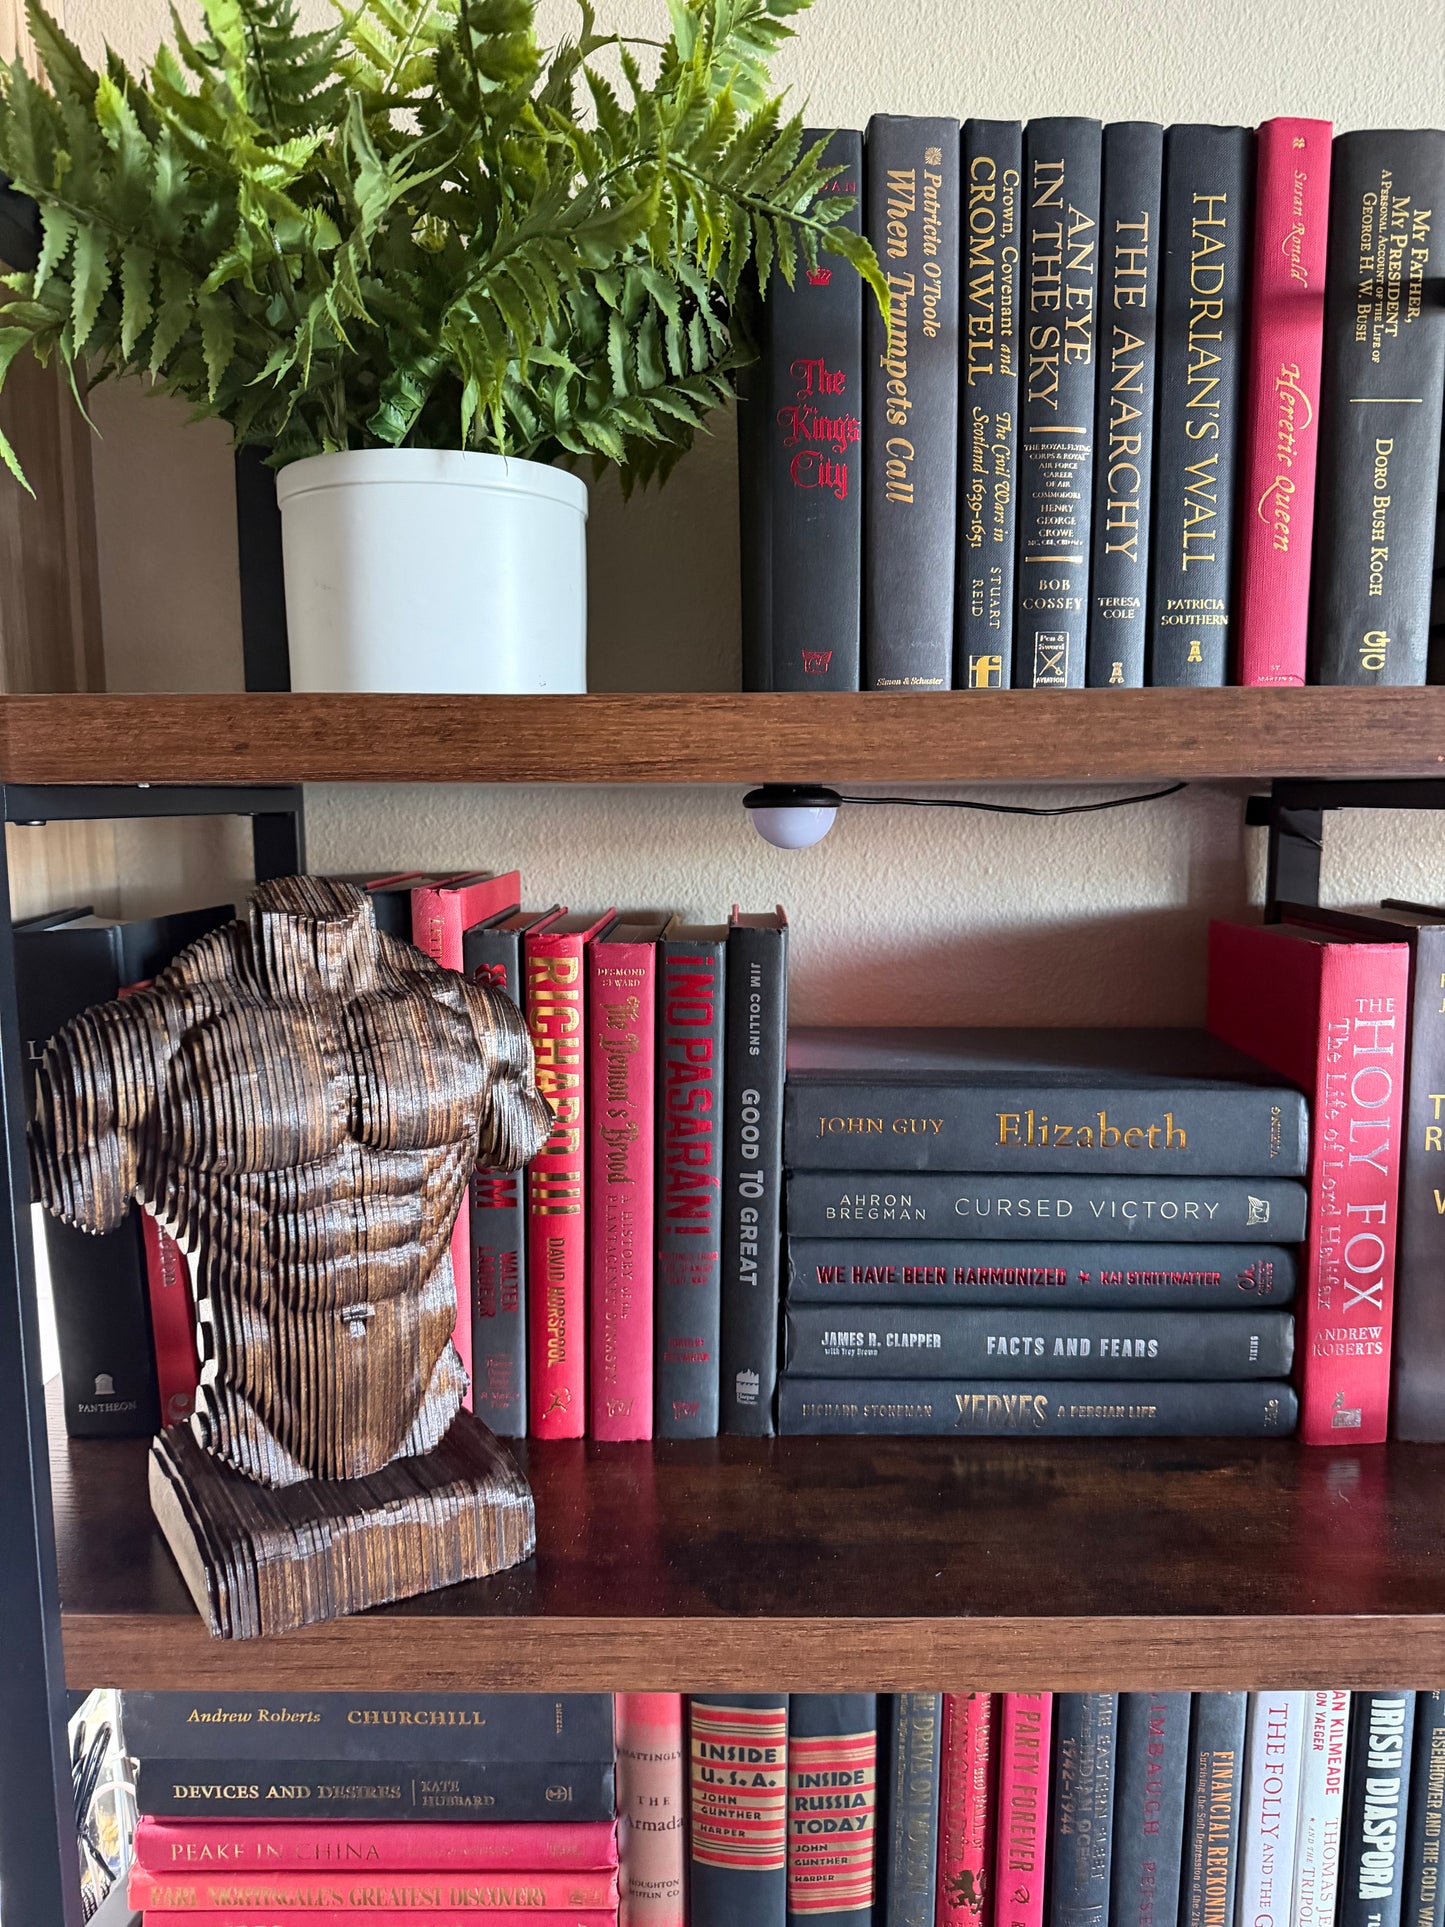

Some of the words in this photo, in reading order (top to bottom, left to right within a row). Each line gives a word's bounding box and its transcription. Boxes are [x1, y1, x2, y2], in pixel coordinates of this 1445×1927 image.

[1032, 158, 1065, 209] IN
[1291, 169, 1307, 216] Susan
[886, 167, 916, 259] When
[922, 169, 942, 257] Patricia
[1066, 203, 1096, 275] AN
[1030, 220, 1063, 313] THE
[1113, 210, 1150, 310] THE
[1281, 222, 1308, 288] Ronald
[967, 156, 997, 387] CROMWELL
[922, 264, 942, 338] O'Toole
[1000, 246, 1019, 337] Covenant
[1063, 284, 1093, 365] EYE
[1185, 192, 1227, 440] HADRIAN'S
[880, 271, 916, 426] Trumpets
[999, 343, 1017, 378] and
[790, 357, 847, 402] The
[1028, 325, 1061, 411] SKY
[776, 404, 860, 453] King's
[995, 411, 1012, 441] The
[1275, 363, 1313, 468] Heretic
[972, 406, 990, 475] Scotland
[1041, 443, 1067, 451] ROYAL
[1105, 324, 1146, 563] ANARCHY
[991, 444, 1011, 479] Civil
[1029, 452, 1055, 460] CORPS
[1055, 452, 1062, 460] &
[1063, 452, 1087, 461] ROYAL
[1054, 462, 1078, 470] FORCE
[790, 449, 849, 500] City
[885, 437, 916, 504] Call
[1043, 471, 1073, 479] CAREER
[993, 480, 1010, 524] Wars
[1032, 491, 1082, 500] COMMODORE
[1040, 504, 1074, 513] HENRY
[1036, 516, 1077, 526] GEORGE
[1181, 453, 1219, 572] WALL
[1257, 474, 1296, 552] Queen
[993, 527, 1009, 543] in
[1038, 528, 1074, 538] CROWE
[988, 566, 1002, 629] STUART
[1039, 579, 1071, 591] BOB
[971, 579, 984, 618] REID
[1023, 597, 1082, 611] COSSEY
[1098, 597, 1141, 608] TERESA
[1166, 599, 1225, 611] PATRICIA
[1102, 608, 1136, 619] COLE
[1161, 614, 1229, 626] SOUTHERN
[1038, 643, 1065, 651] Sword
[1039, 634, 1056, 642] Pen
[1056, 634, 1065, 642] &
[876, 677, 901, 686] Simon
[902, 677, 910, 686] &
[910, 676, 944, 686] Schuster
[597, 967, 646, 977] DESMOND
[602, 978, 641, 989] SEWARD
[749, 962, 761, 988] JIM
[1355, 997, 1395, 1013] THE
[749, 993, 761, 1057] COLLINS
[1326, 1017, 1351, 1064] The
[1324, 1072, 1348, 1121] Life
[1348, 1015, 1396, 1177] HOLY
[740, 1088, 761, 1160] GOOD
[816, 1116, 884, 1138] JOHN
[892, 1118, 945, 1136] GUY
[995, 1108, 1190, 1150] Elizabeth
[1323, 1129, 1346, 1153] of
[739, 1170, 764, 1199] TO
[1321, 1160, 1344, 1217] Lord
[840, 1194, 913, 1207] AHRON
[954, 1198, 1073, 1218] CURSED
[1089, 1199, 1220, 1220] VICTORY
[826, 1207, 927, 1221] BREGMAN
[546, 1236, 566, 1282] DAVID
[739, 1206, 760, 1287] GREAT
[1342, 1199, 1387, 1314] FOX
[499, 1250, 518, 1313] WALTER
[816, 1265, 846, 1285] WE
[851, 1265, 896, 1285] HAVE
[902, 1266, 948, 1285] BEEN
[953, 1267, 1067, 1287] HARMONIZED
[1100, 1271, 1123, 1286] KAI
[821, 1331, 865, 1347] JAMES
[868, 1332, 882, 1347] R.
[886, 1332, 942, 1348] CLAPPER
[987, 1336, 1045, 1356] FACTS
[1053, 1338, 1091, 1357] AND
[1100, 1338, 1159, 1358] FEARS
[1315, 1326, 1384, 1341] ANDREW
[1312, 1341, 1384, 1357] ROBERTS
[78, 1400, 136, 1413] PANTHEON
[1057, 1405, 1067, 1417] A
[1070, 1405, 1126, 1418] PERSIAN
[1129, 1405, 1157, 1419] LIFE
[186, 1707, 253, 1724] Andrew
[256, 1708, 322, 1724] Roberts
[347, 1710, 487, 1726] CHURCHILL
[1265, 1703, 1289, 1756] THE
[1013, 1710, 1042, 1776] PARTY
[1312, 1711, 1326, 1751] YAEGER
[1367, 1698, 1406, 1769] IRISH
[699, 1742, 778, 1764] INSIDE
[1325, 1717, 1346, 1795] KILMEADE
[421, 1780, 460, 1793] KATE
[700, 1766, 778, 1788] U.S.A.
[797, 1769, 866, 1789] INSIDE
[172, 1784, 260, 1800] DEVICES
[265, 1784, 312, 1800] AND
[316, 1785, 402, 1800] DESIRES
[421, 1795, 496, 1808] HUBBARD
[637, 1795, 671, 1807] THE
[701, 1791, 738, 1806] JOHN
[794, 1792, 867, 1812] RUSSIA
[1196, 1795, 1207, 1811] the
[1208, 1750, 1234, 1842] FINANCIAL
[1260, 1762, 1284, 1839] FOLLY
[624, 1813, 684, 1833] Armada
[700, 1806, 762, 1821] GUNTHER
[793, 1814, 869, 1835] TODAY
[1195, 1812, 1206, 1832] Soft
[1425, 1812, 1443, 1837] AND
[700, 1824, 746, 1838] HARPER
[1009, 1784, 1037, 1873] FOREVER
[1308, 1825, 1316, 1845] AND
[1358, 1777, 1401, 1900] DIASPORA
[256, 1844, 284, 1859] IN
[295, 1843, 381, 1861] CHINA
[795, 1843, 829, 1853] JOHN
[1193, 1833, 1205, 1881] Depression
[1261, 1843, 1274, 1875] AND
[1305, 1846, 1314, 1863] THE
[1320, 1817, 1339, 1901] THOMAS
[1423, 1839, 1440, 1864] THE
[794, 1856, 849, 1867] GUNTHER
[628, 1878, 681, 1889] HOUGHTON
[794, 1873, 836, 1883] HARPER
[1420, 1866, 1438, 1902] COLD
[349, 1885, 444, 1908] GREATEST
[449, 1886, 547, 1908] DISCOVERY
[1259, 1879, 1273, 1908] THE
